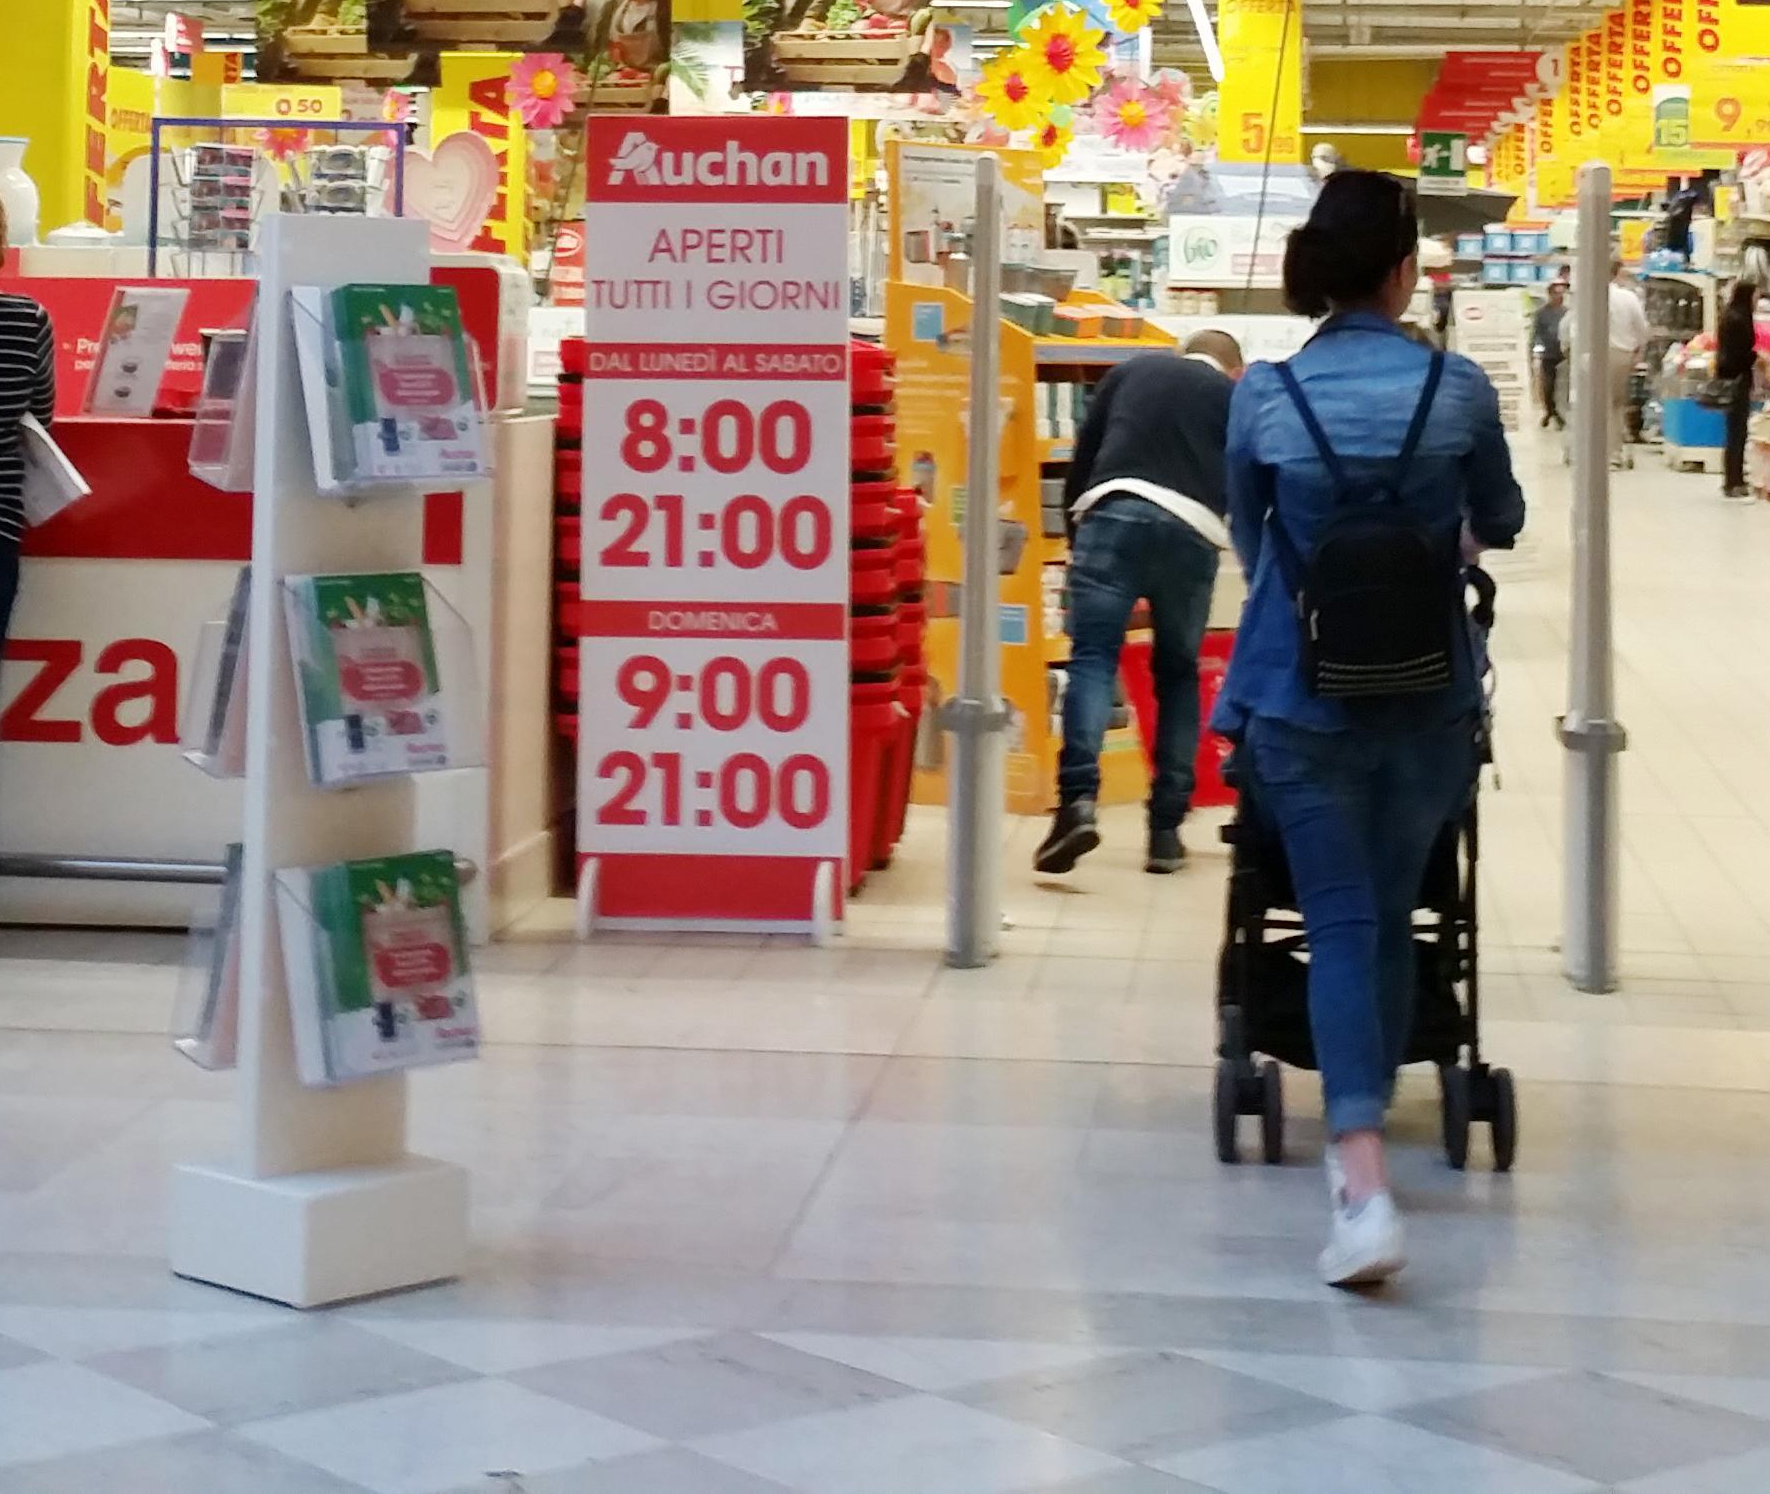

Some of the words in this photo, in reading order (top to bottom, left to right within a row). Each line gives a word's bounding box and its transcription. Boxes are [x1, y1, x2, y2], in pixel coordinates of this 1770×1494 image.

[1587, 32, 1602, 129] OFFERTA
[1607, 11, 1625, 117] OFFERTA
[607, 131, 828, 187] Auchan
[648, 228, 784, 264] APERTI
[591, 280, 671, 310] TUTTI
[686, 281, 692, 309] I
[707, 280, 841, 311] GIORNI
[589, 353, 633, 373] DAL
[640, 348, 717, 373] LUNEDÌ
[723, 354, 749, 373] AL
[756, 354, 843, 374] SABATO
[620, 398, 813, 475] 8:00
[598, 493, 832, 570] 21:00
[648, 610, 778, 632] DOMENICA
[616, 654, 811, 733] 9:00
[596, 750, 830, 830] 21:00
